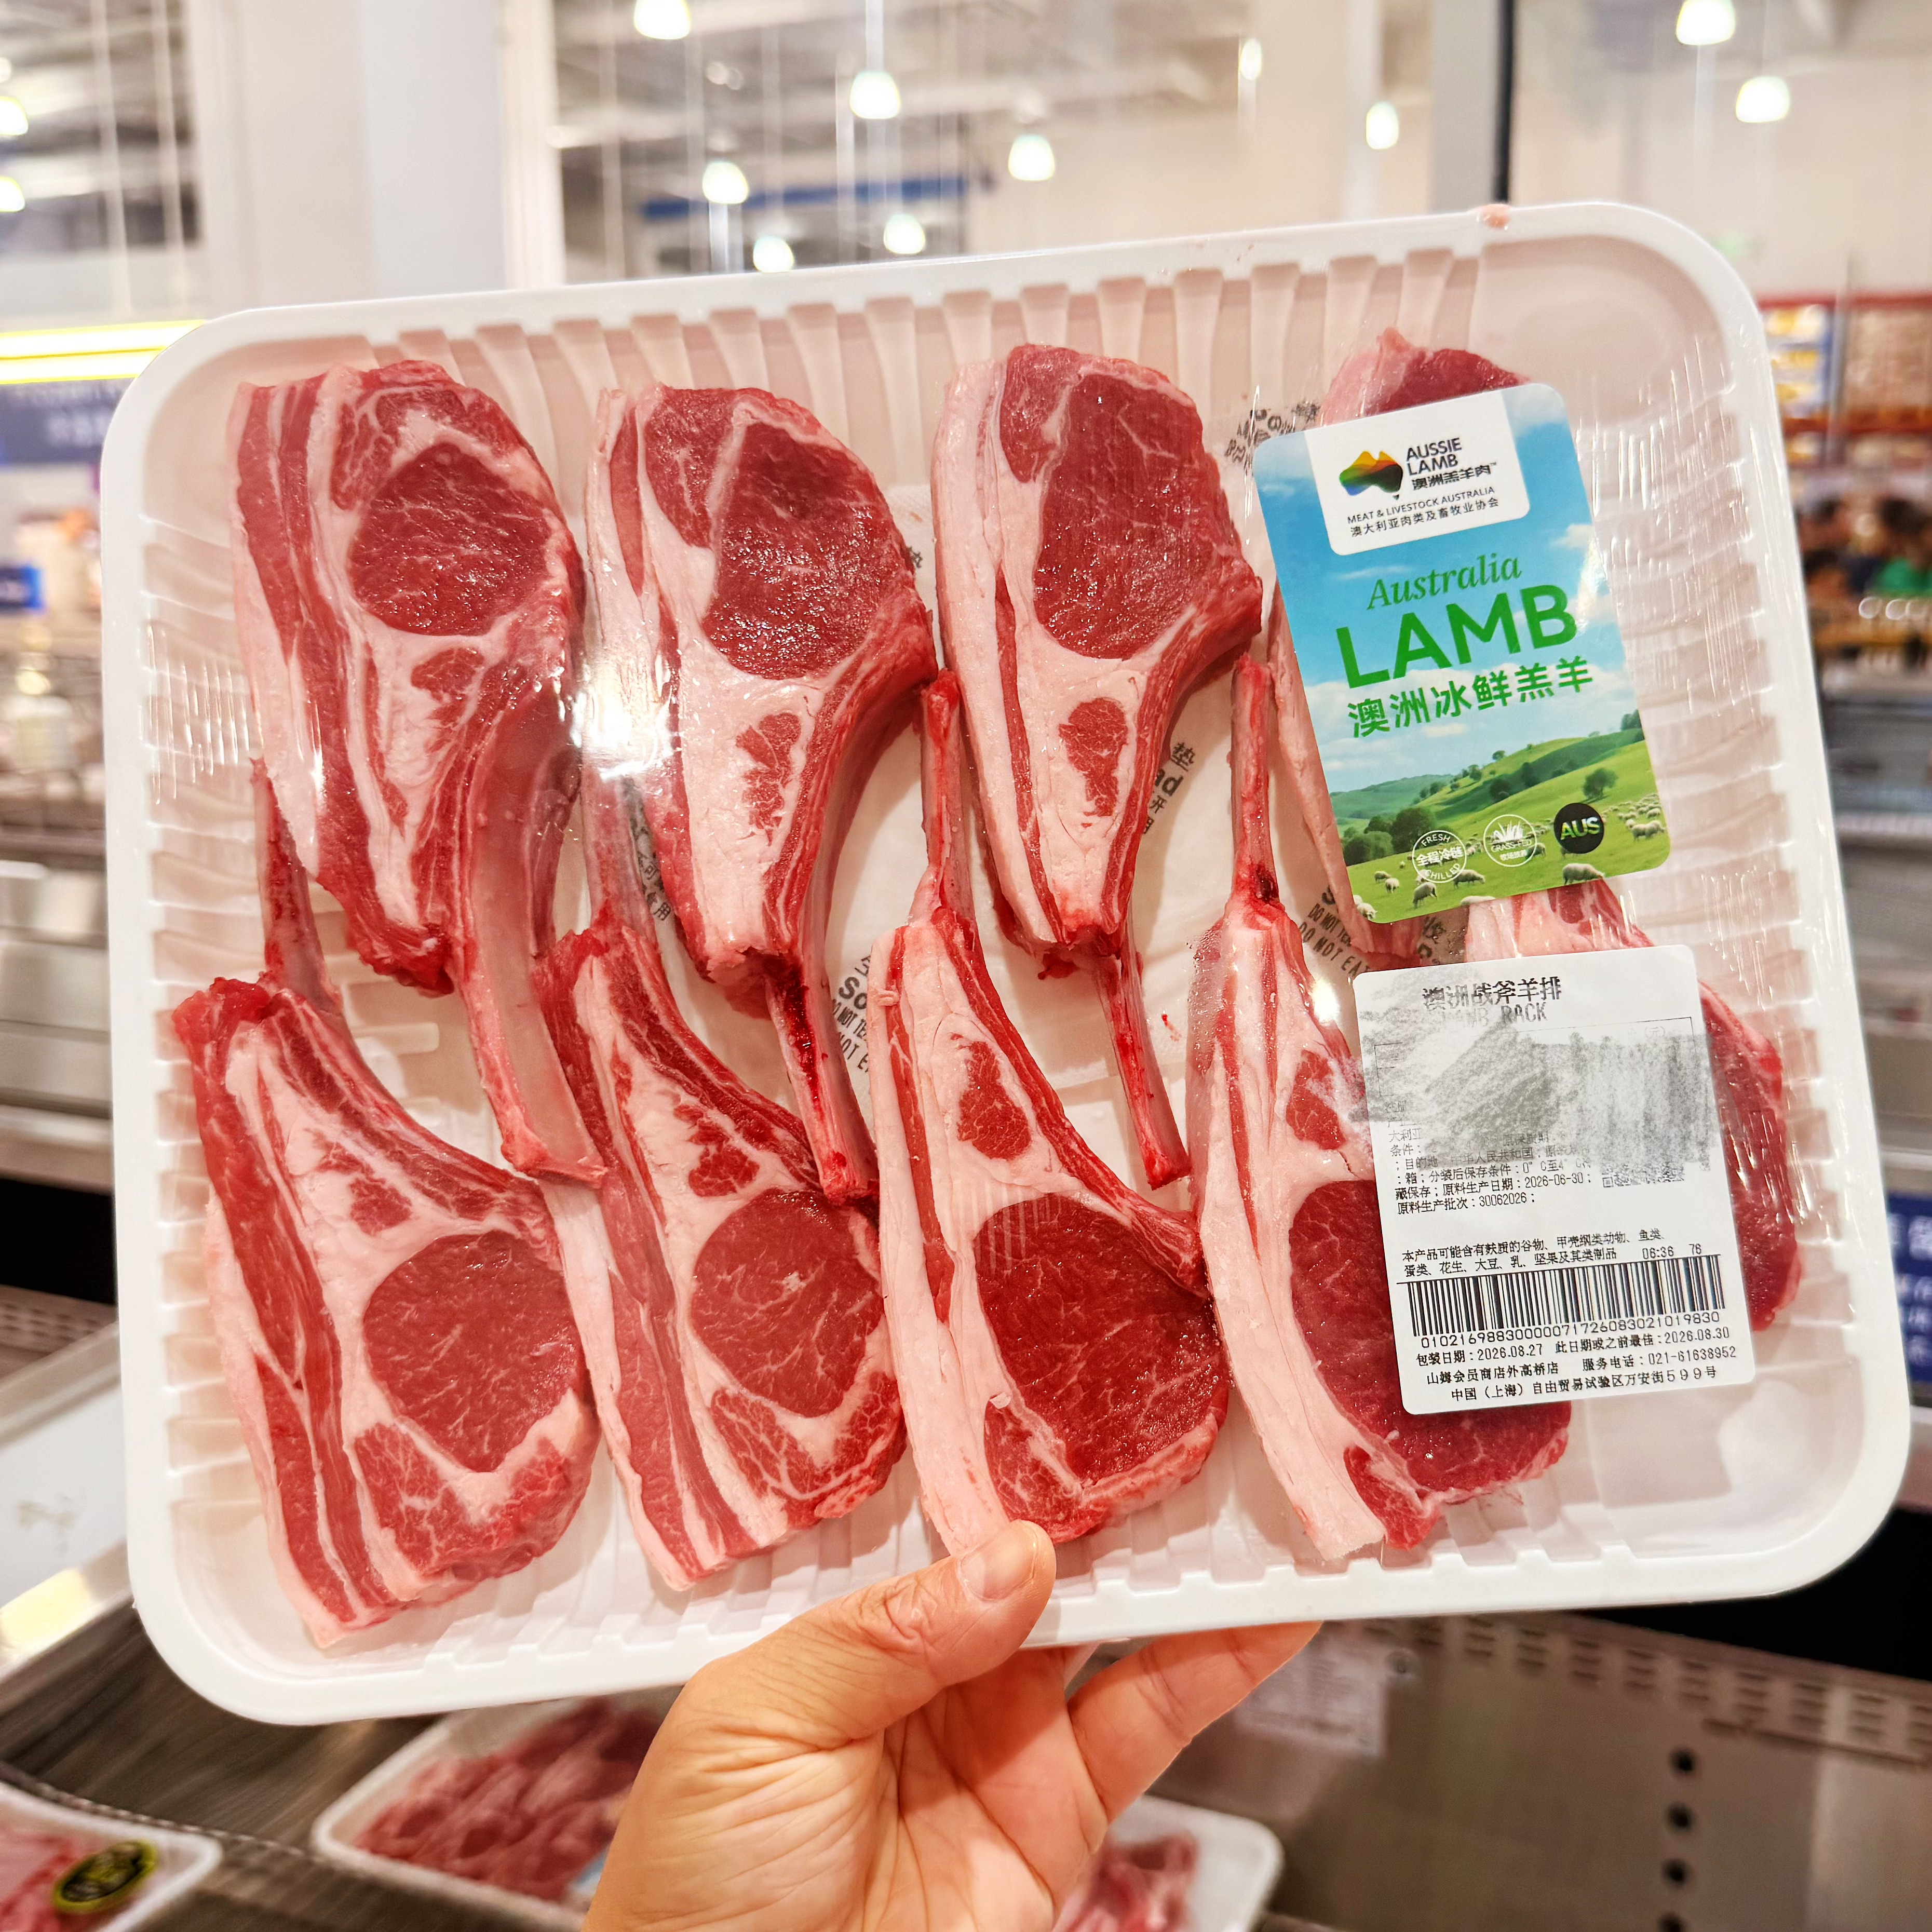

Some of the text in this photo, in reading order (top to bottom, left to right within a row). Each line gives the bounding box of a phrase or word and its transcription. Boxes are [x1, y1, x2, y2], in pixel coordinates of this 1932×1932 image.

[1406, 438, 1462, 462] AUSSIE
[1407, 454, 1458, 476] LAMB
[1412, 465, 1491, 491] 澳洲羔羊肉
[1347, 486, 1495, 524] MEAT & LIVESTOCK AUSTRALIA
[1350, 497, 1499, 537] 澳大利亚肉类及畜牧业协会
[1366, 552, 1522, 611] Australia
[1336, 585, 1577, 689] LAMB
[1348, 655, 1593, 738] 澳洲冰鲜羔羊
[1154, 768, 1184, 796] ad
[1421, 833, 1451, 847] FRESH
[1560, 817, 1600, 840] AUS
[1424, 863, 1461, 880] CHILLED
[1423, 976, 1562, 1011] 澳洲战斧羊排
[1440, 1002, 1548, 1027] MB RACK
[1421, 1311, 1720, 1348] 01021698830000071726083021019830
